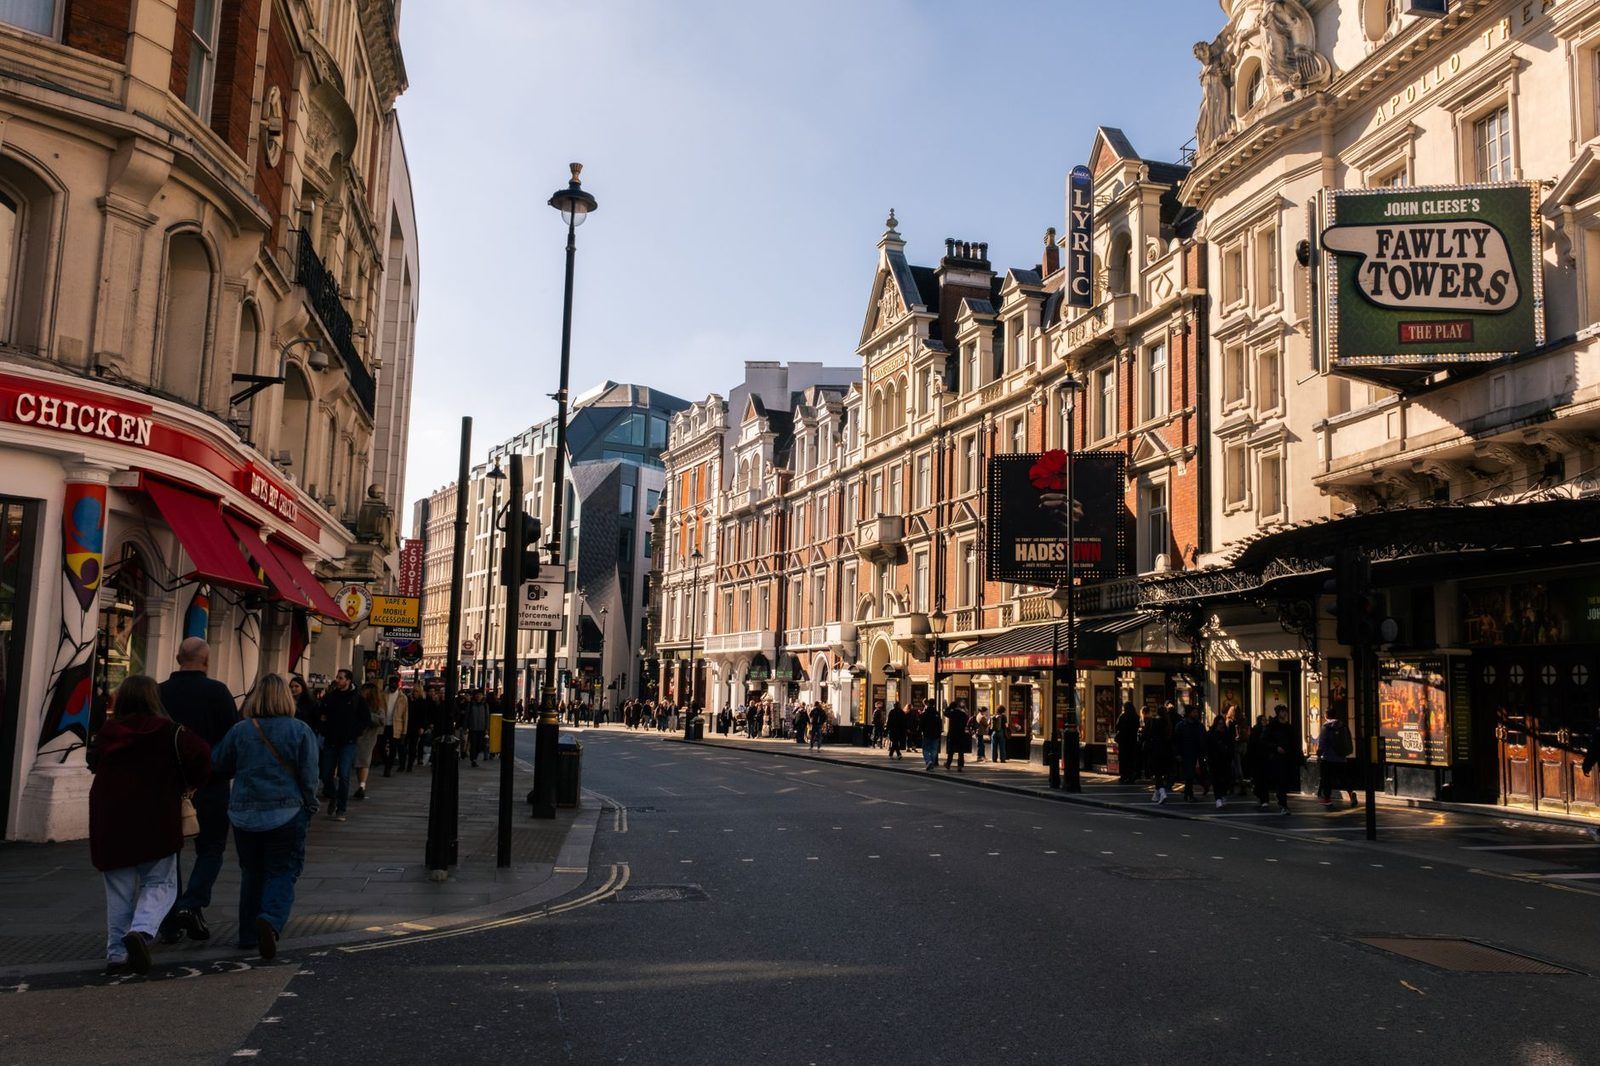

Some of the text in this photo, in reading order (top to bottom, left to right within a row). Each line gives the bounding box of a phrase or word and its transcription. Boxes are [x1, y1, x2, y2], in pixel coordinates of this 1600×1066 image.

[1376, 53, 1460, 126] APOLLO
[1384, 199, 1480, 217] JOHN CLEESE'S
[1072, 189, 1090, 296] LYRIC
[1376, 228, 1490, 260] FAWLTY
[1367, 261, 1510, 305] TOWERS
[1408, 324, 1463, 340] THE PLAY
[16, 393, 153, 446] CHICKEN
[1015, 542, 1101, 561] HADESOWN
[408, 548, 417, 592] COYOTE
[518, 611, 560, 620] nforcement
[524, 603, 549, 611] Traffic
[373, 615, 415, 624] ACCESSORIES
[962, 660, 972, 669] THE
[972, 659, 985, 669] BEST
